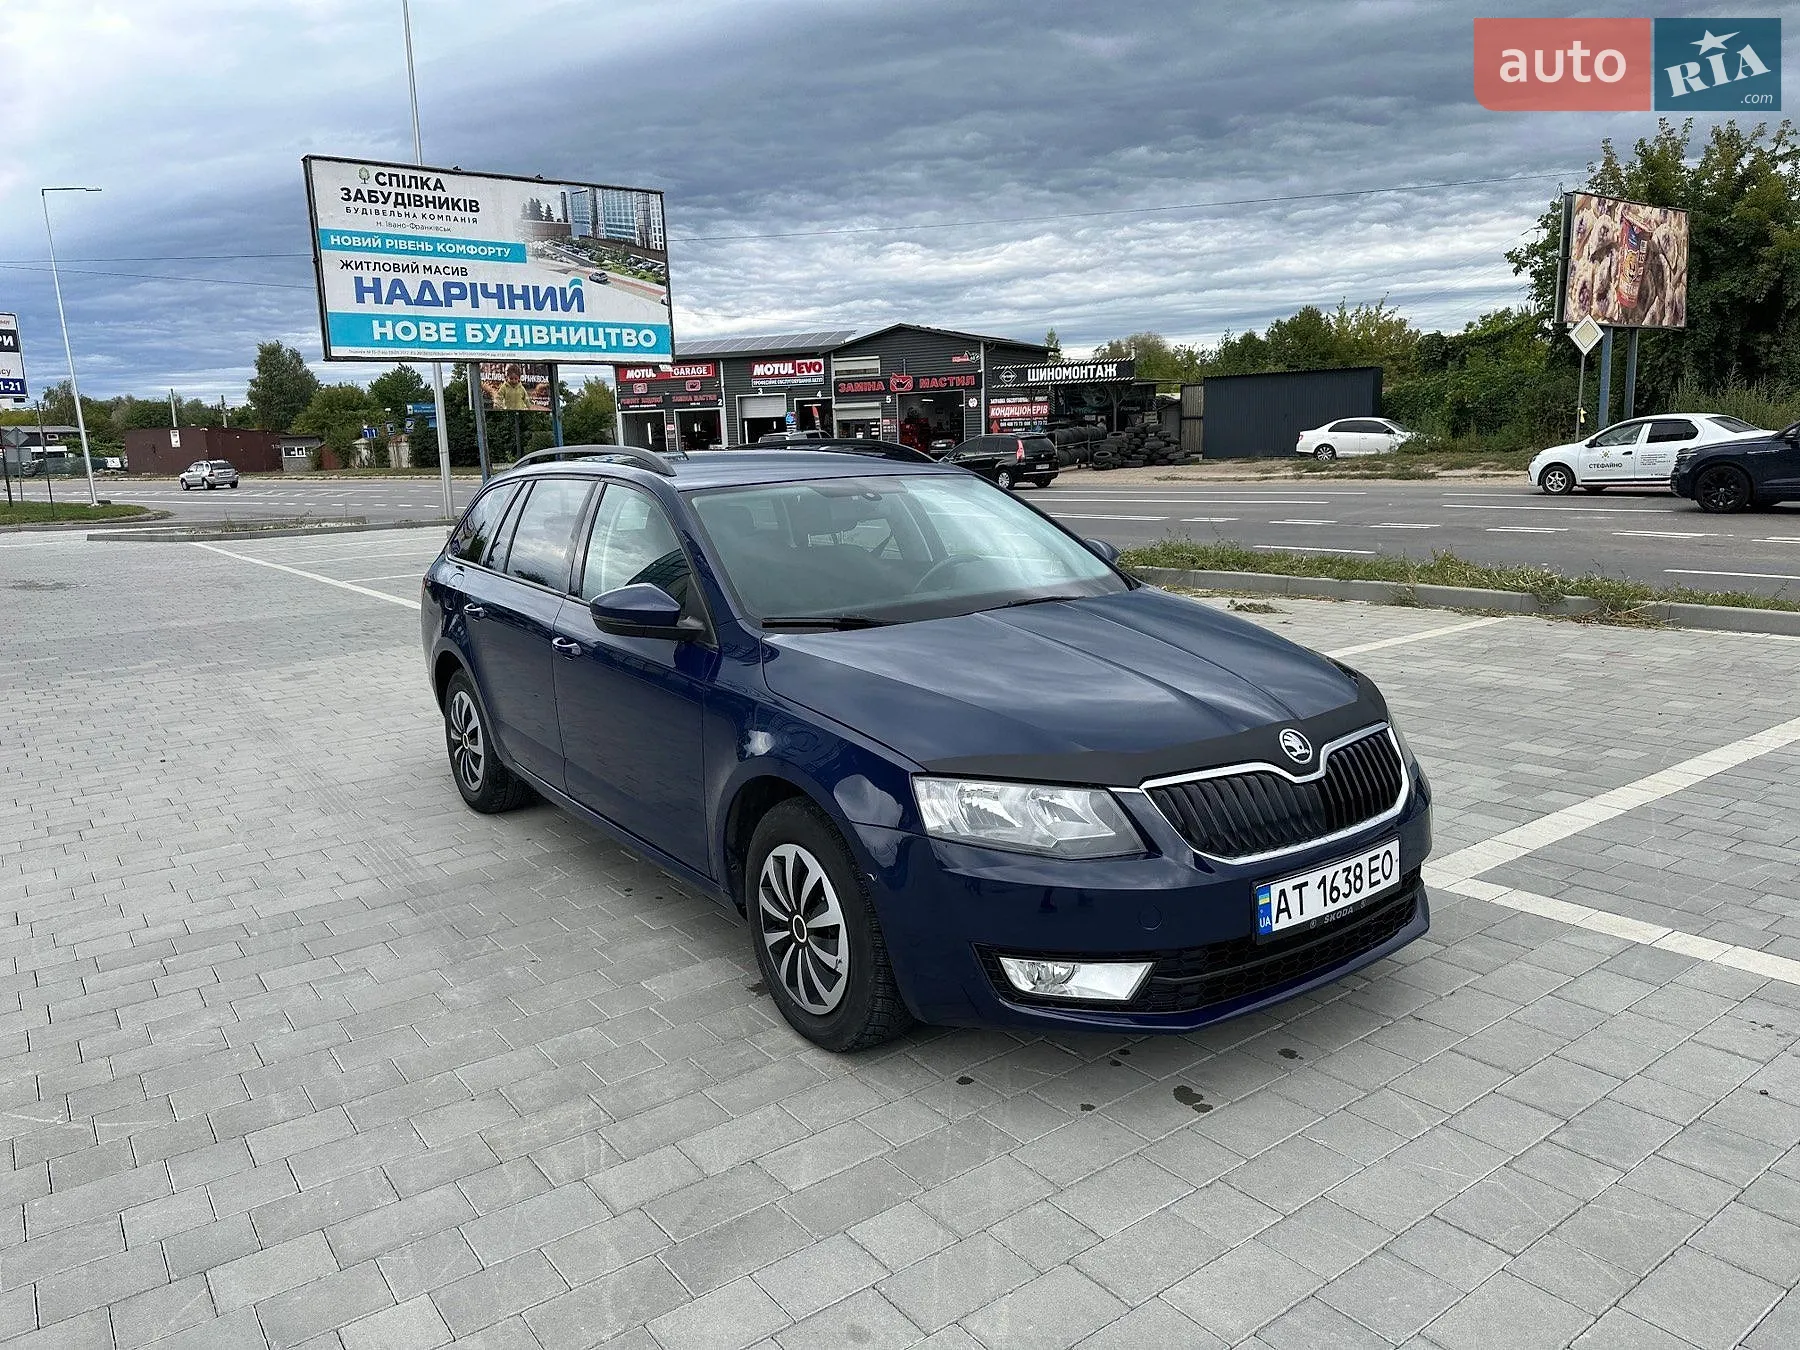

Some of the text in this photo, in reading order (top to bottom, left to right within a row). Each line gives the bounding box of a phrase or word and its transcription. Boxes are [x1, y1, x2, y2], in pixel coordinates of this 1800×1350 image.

[374, 172, 447, 193] СПІЛКА
[340, 187, 480, 213] ЗАБУДІВНИКІВ
[345, 206, 479, 225] БУДІВЕЛЬНА КОМПАНІЯ
[330, 234, 511, 258] НОВИЙ РІВЕНЬ КОМФОРТУ
[340, 259, 469, 277] ЖИТЛОВИЙ МАСИВ
[354, 276, 586, 313] НАДРІЧНИЙ
[372, 320, 657, 349] НОВЕ БУДІВНИЦТВО
[626, 366, 708, 379] MOTUL GARAGE
[753, 360, 822, 376] MOTUL EVO
[1027, 363, 1118, 382] ШИНОМОНТАЖ
[838, 375, 976, 393] ЗАМІНА МАСТИЛ
[990, 405, 1048, 418] КОНДИЦІОНЕРІВ
[1274, 849, 1393, 924] AT 1638 EO
[1259, 917, 1271, 928] UA
[1323, 908, 1354, 924] SKODA
